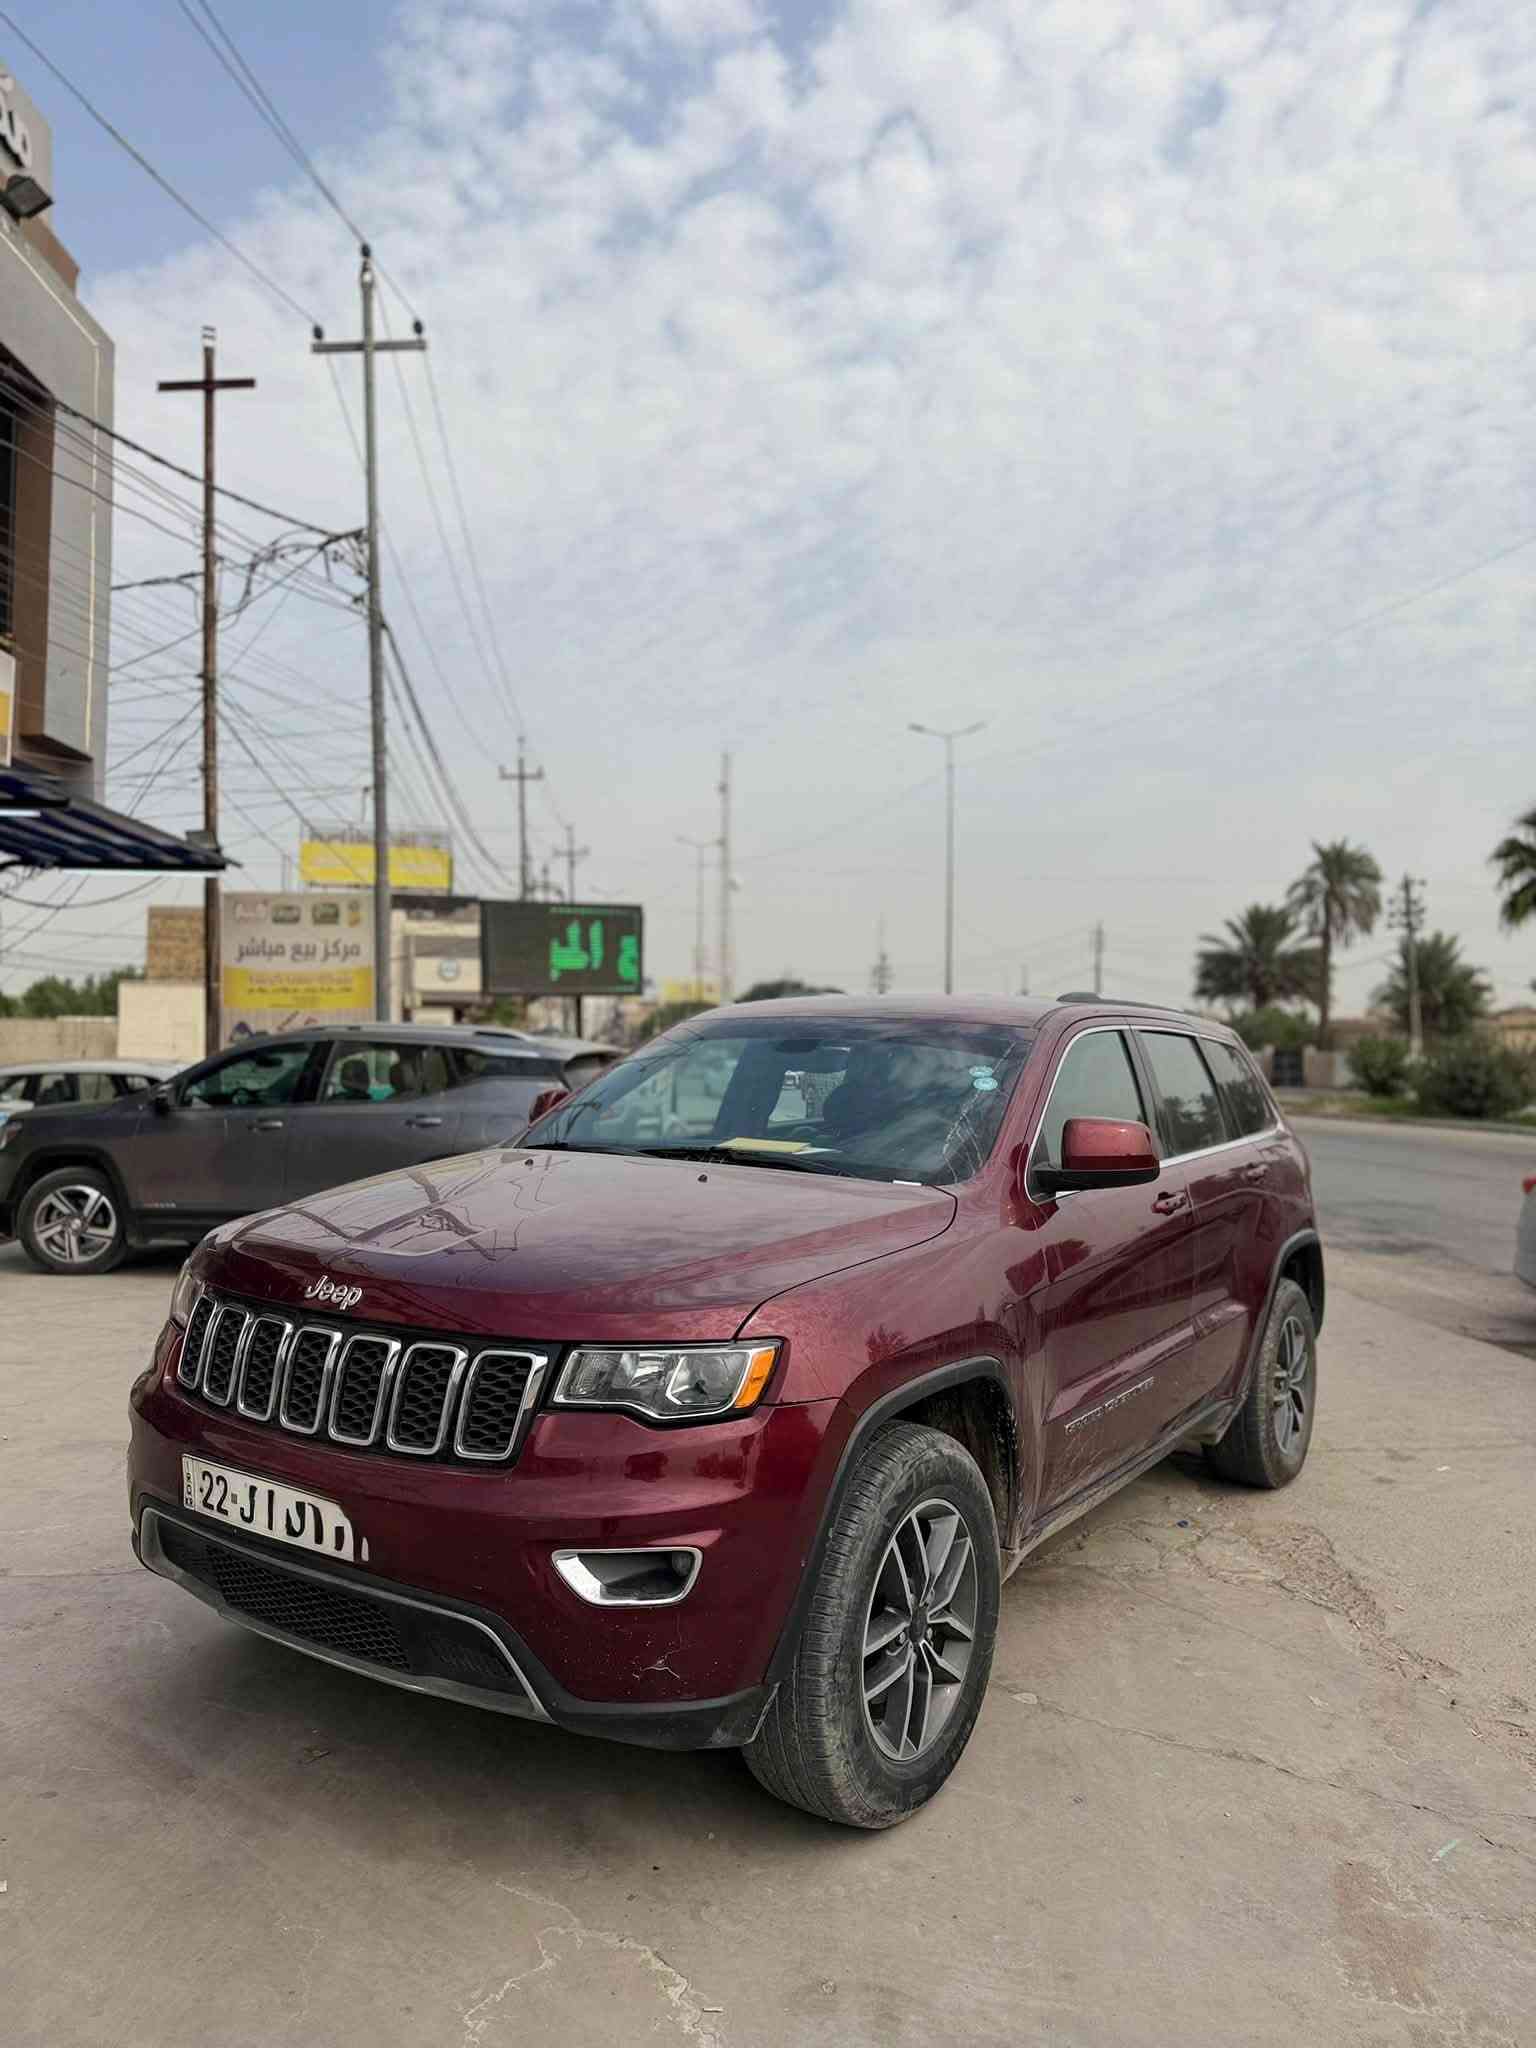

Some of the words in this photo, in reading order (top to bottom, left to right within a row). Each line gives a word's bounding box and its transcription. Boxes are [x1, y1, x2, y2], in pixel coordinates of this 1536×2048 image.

[233, 936, 287, 963] مباشر
[289, 942, 318, 963] بيع
[318, 937, 361, 962] مركز
[304, 1274, 363, 1310] Jeep
